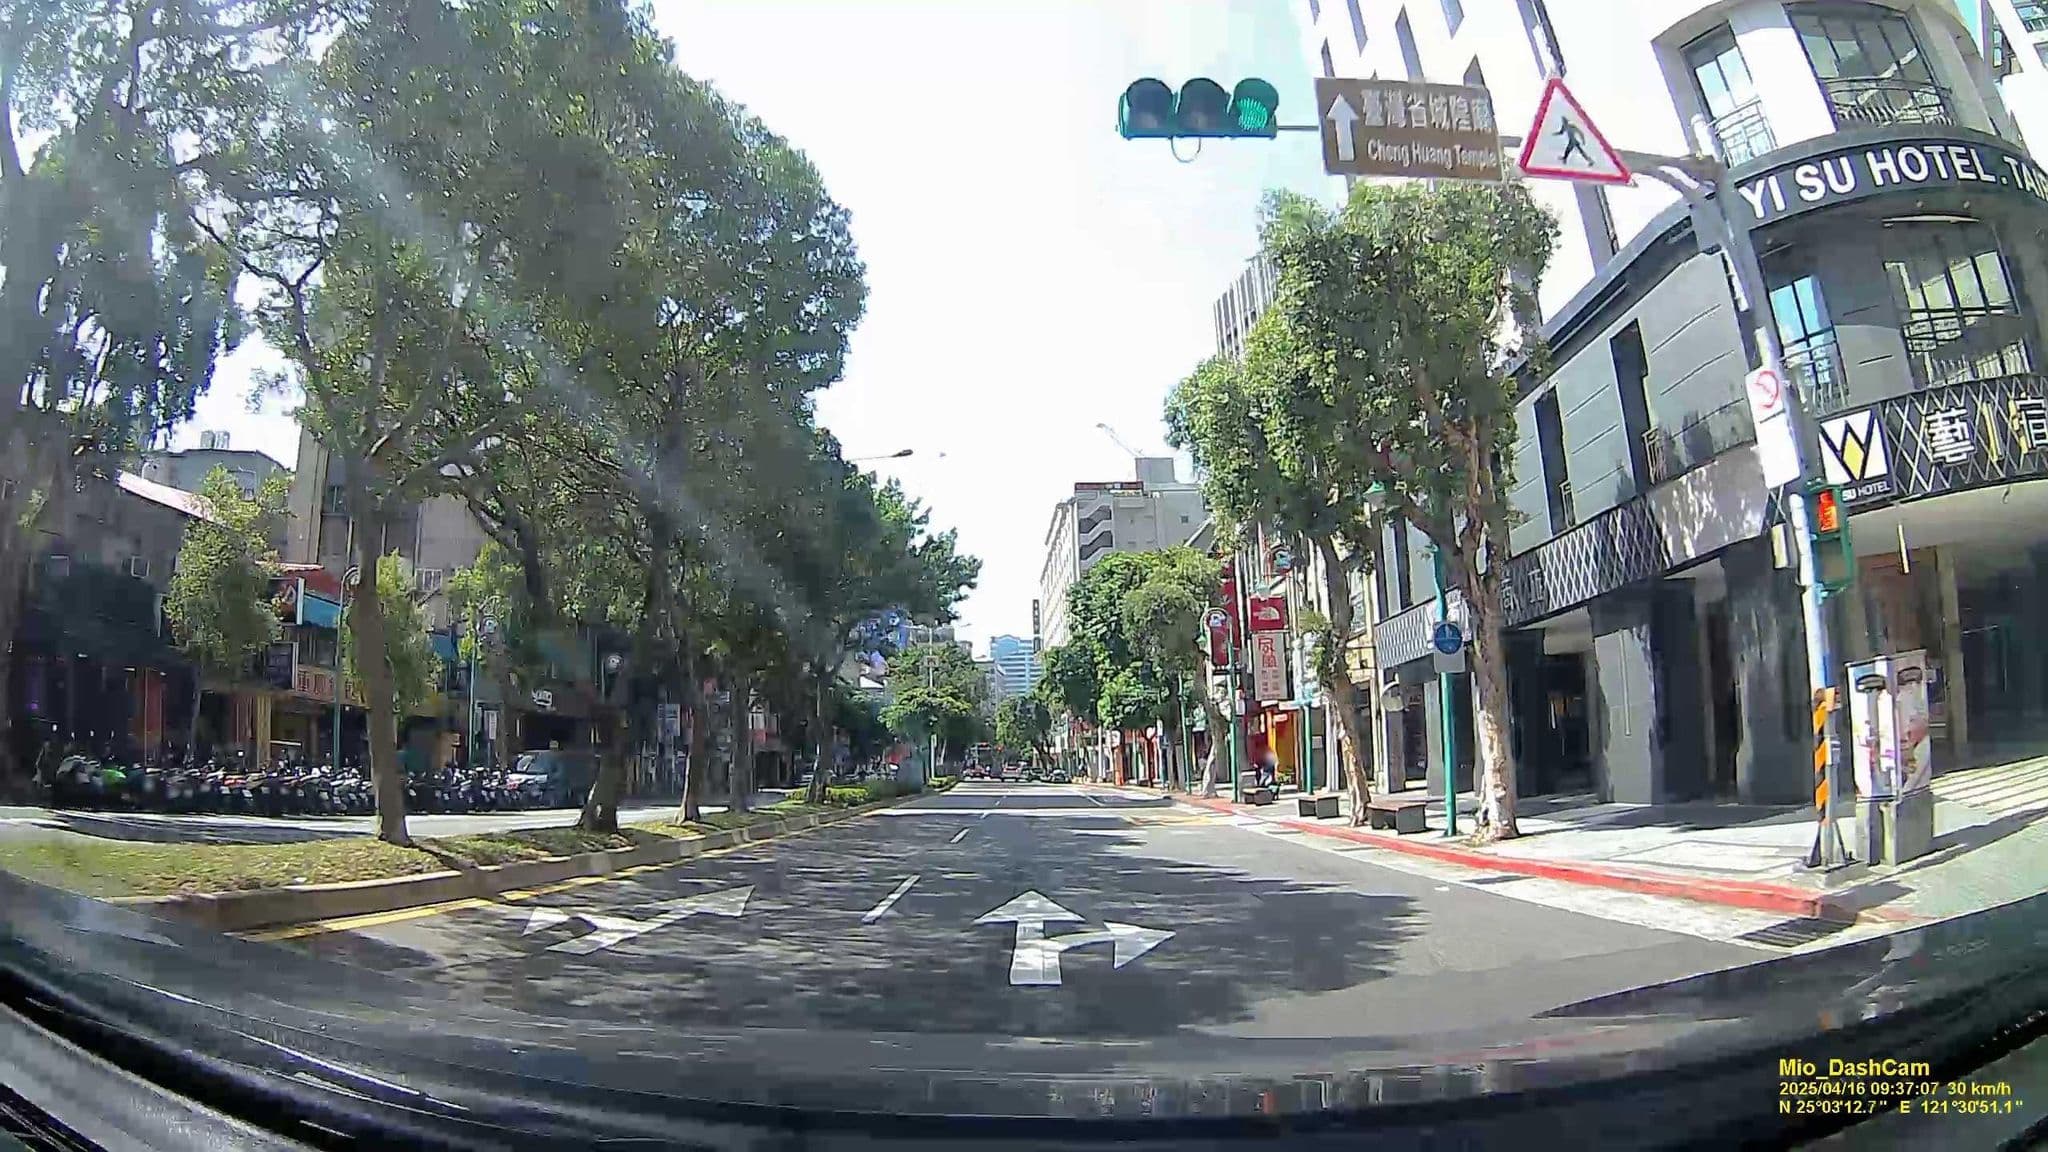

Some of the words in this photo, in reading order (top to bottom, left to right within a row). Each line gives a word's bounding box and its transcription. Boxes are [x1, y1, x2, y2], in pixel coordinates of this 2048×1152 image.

[1412, 140, 1453, 170] Huang
[1454, 144, 1498, 172] Temple
[1738, 175, 1786, 219] YI
[1794, 155, 1856, 202] SU
[1858, 480, 1891, 497] HOTEL
